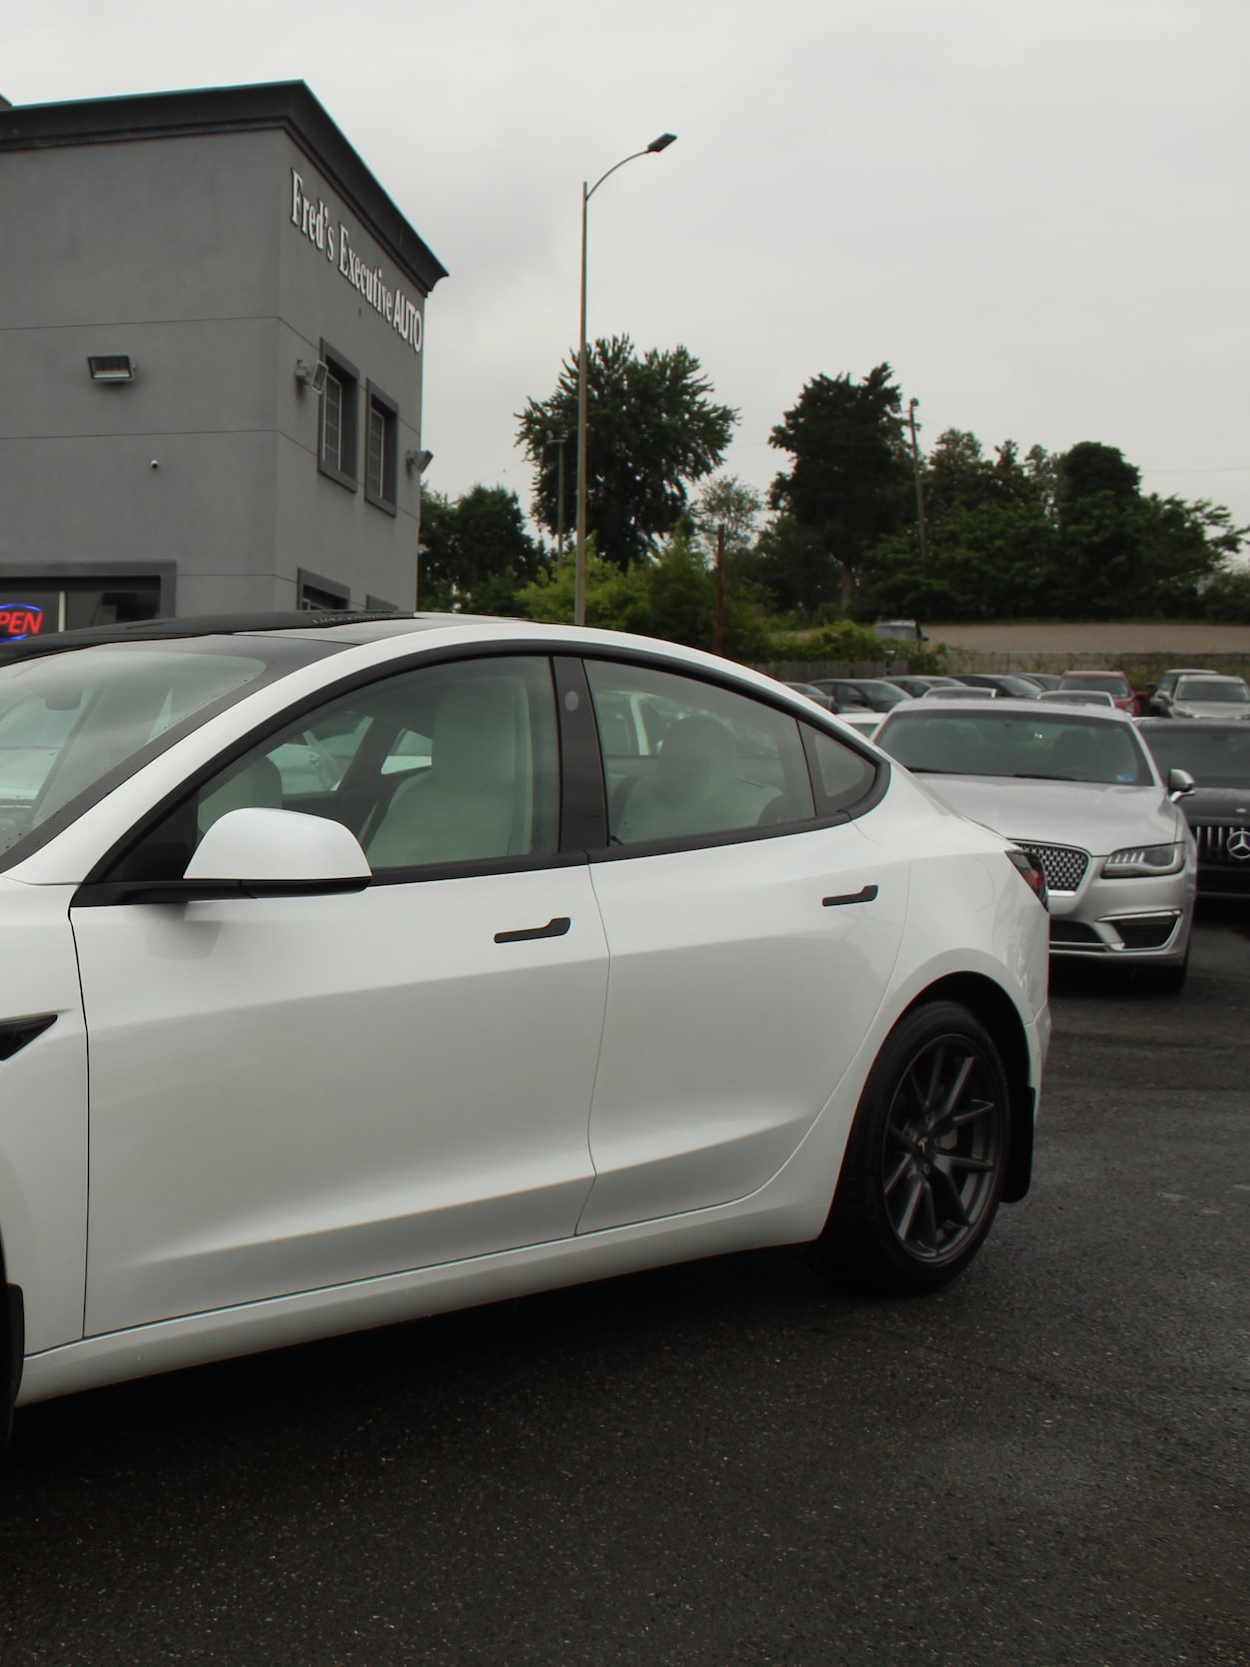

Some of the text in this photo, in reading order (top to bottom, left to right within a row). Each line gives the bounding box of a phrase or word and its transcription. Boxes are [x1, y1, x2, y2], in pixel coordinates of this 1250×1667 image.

[290, 168, 423, 352] Fred's Executive AUTO
